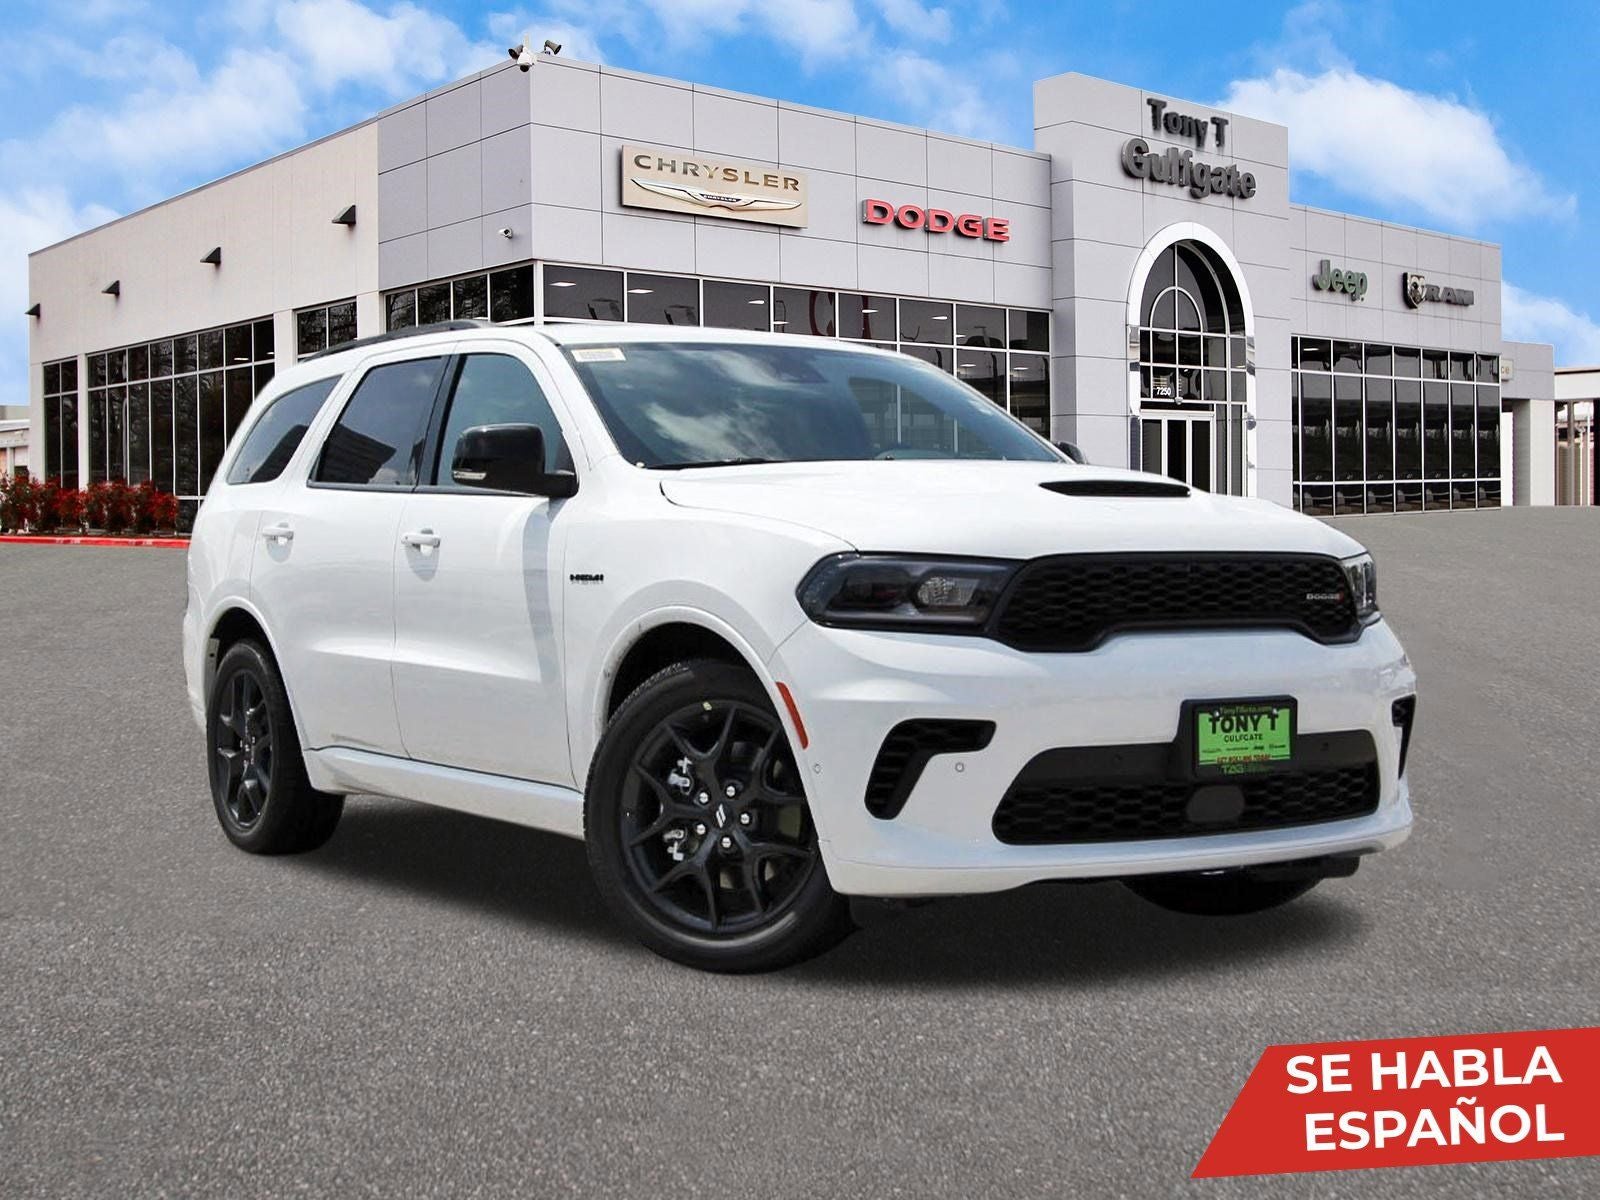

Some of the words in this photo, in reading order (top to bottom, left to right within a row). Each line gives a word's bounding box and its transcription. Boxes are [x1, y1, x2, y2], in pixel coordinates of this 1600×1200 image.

[1147, 98, 1209, 146] Tony
[1211, 116, 1229, 147] T
[633, 154, 801, 192] CHRYSLER
[1121, 138, 1256, 199] Gulfgate
[862, 199, 1010, 242] DODGE
[1312, 259, 1368, 302] Jeep
[1425, 284, 1475, 306] RAM
[1156, 387, 1172, 396] 7250
[1209, 713, 1261, 734] TONY
[1267, 711, 1279, 731] T
